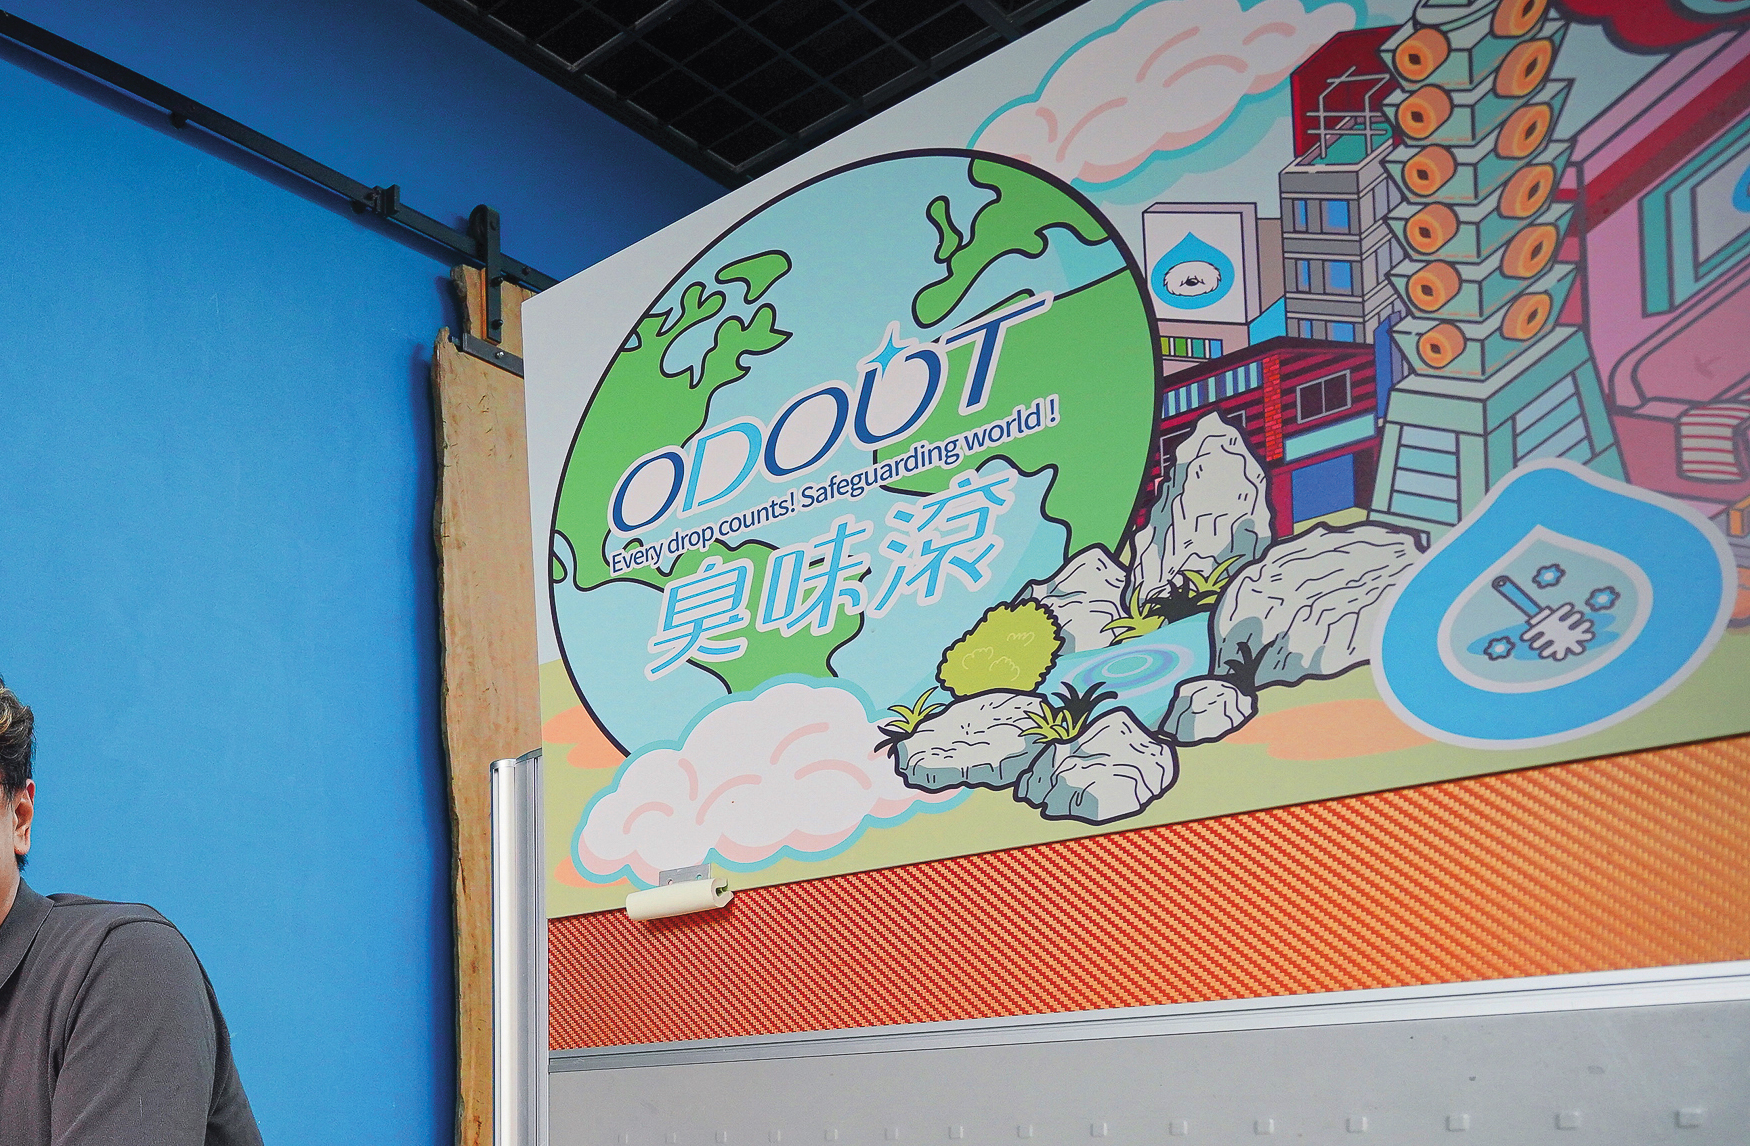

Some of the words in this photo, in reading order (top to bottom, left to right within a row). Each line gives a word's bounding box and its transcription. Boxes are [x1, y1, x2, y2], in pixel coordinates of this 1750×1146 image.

[611, 539, 664, 574] Every
[667, 526, 715, 556] drop
[718, 492, 797, 537] counts!
[800, 437, 960, 509] Safeguarding
[963, 404, 1042, 452] world
[612, 299, 1047, 533] ODOUT
[650, 477, 1011, 676] 臭味滾
